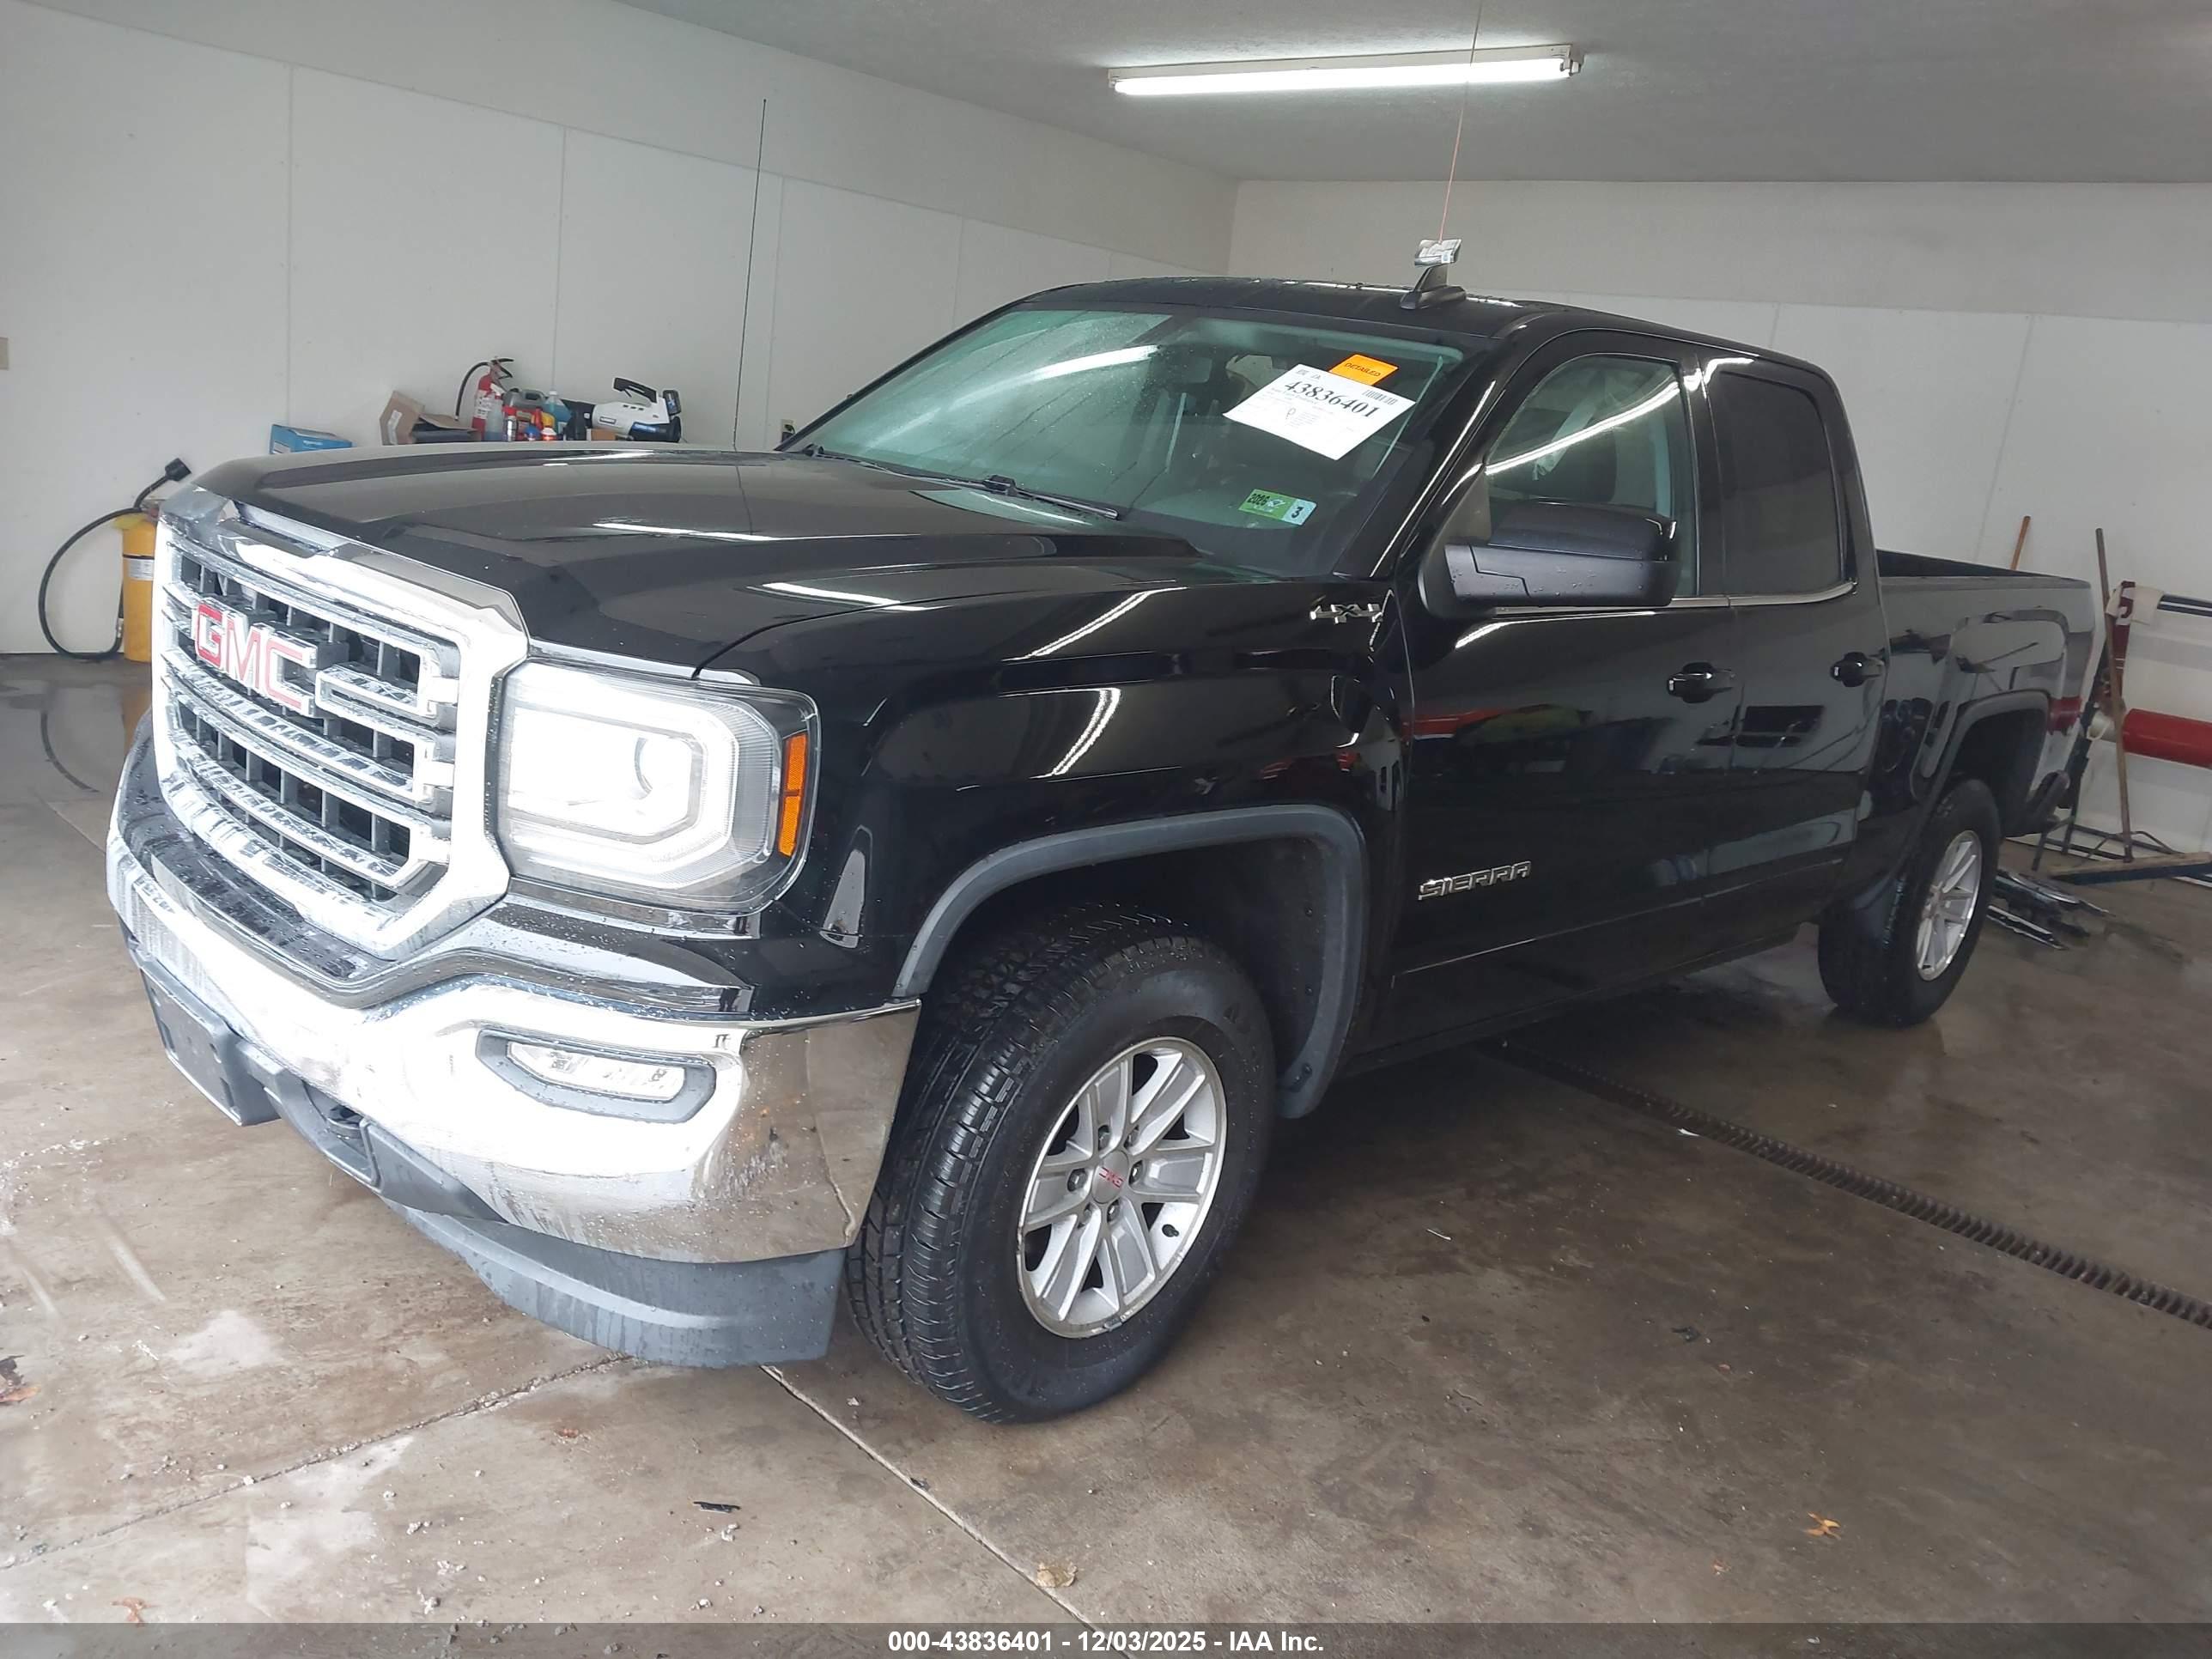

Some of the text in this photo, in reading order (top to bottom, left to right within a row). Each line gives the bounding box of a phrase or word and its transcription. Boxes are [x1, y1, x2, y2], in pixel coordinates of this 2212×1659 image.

[1344, 362, 1382, 377] DETAILED
[1285, 380, 1380, 417] 43836401
[1291, 506, 1304, 519] 3
[193, 599, 314, 717] GMC
[1418, 860, 1532, 901] SIERRA
